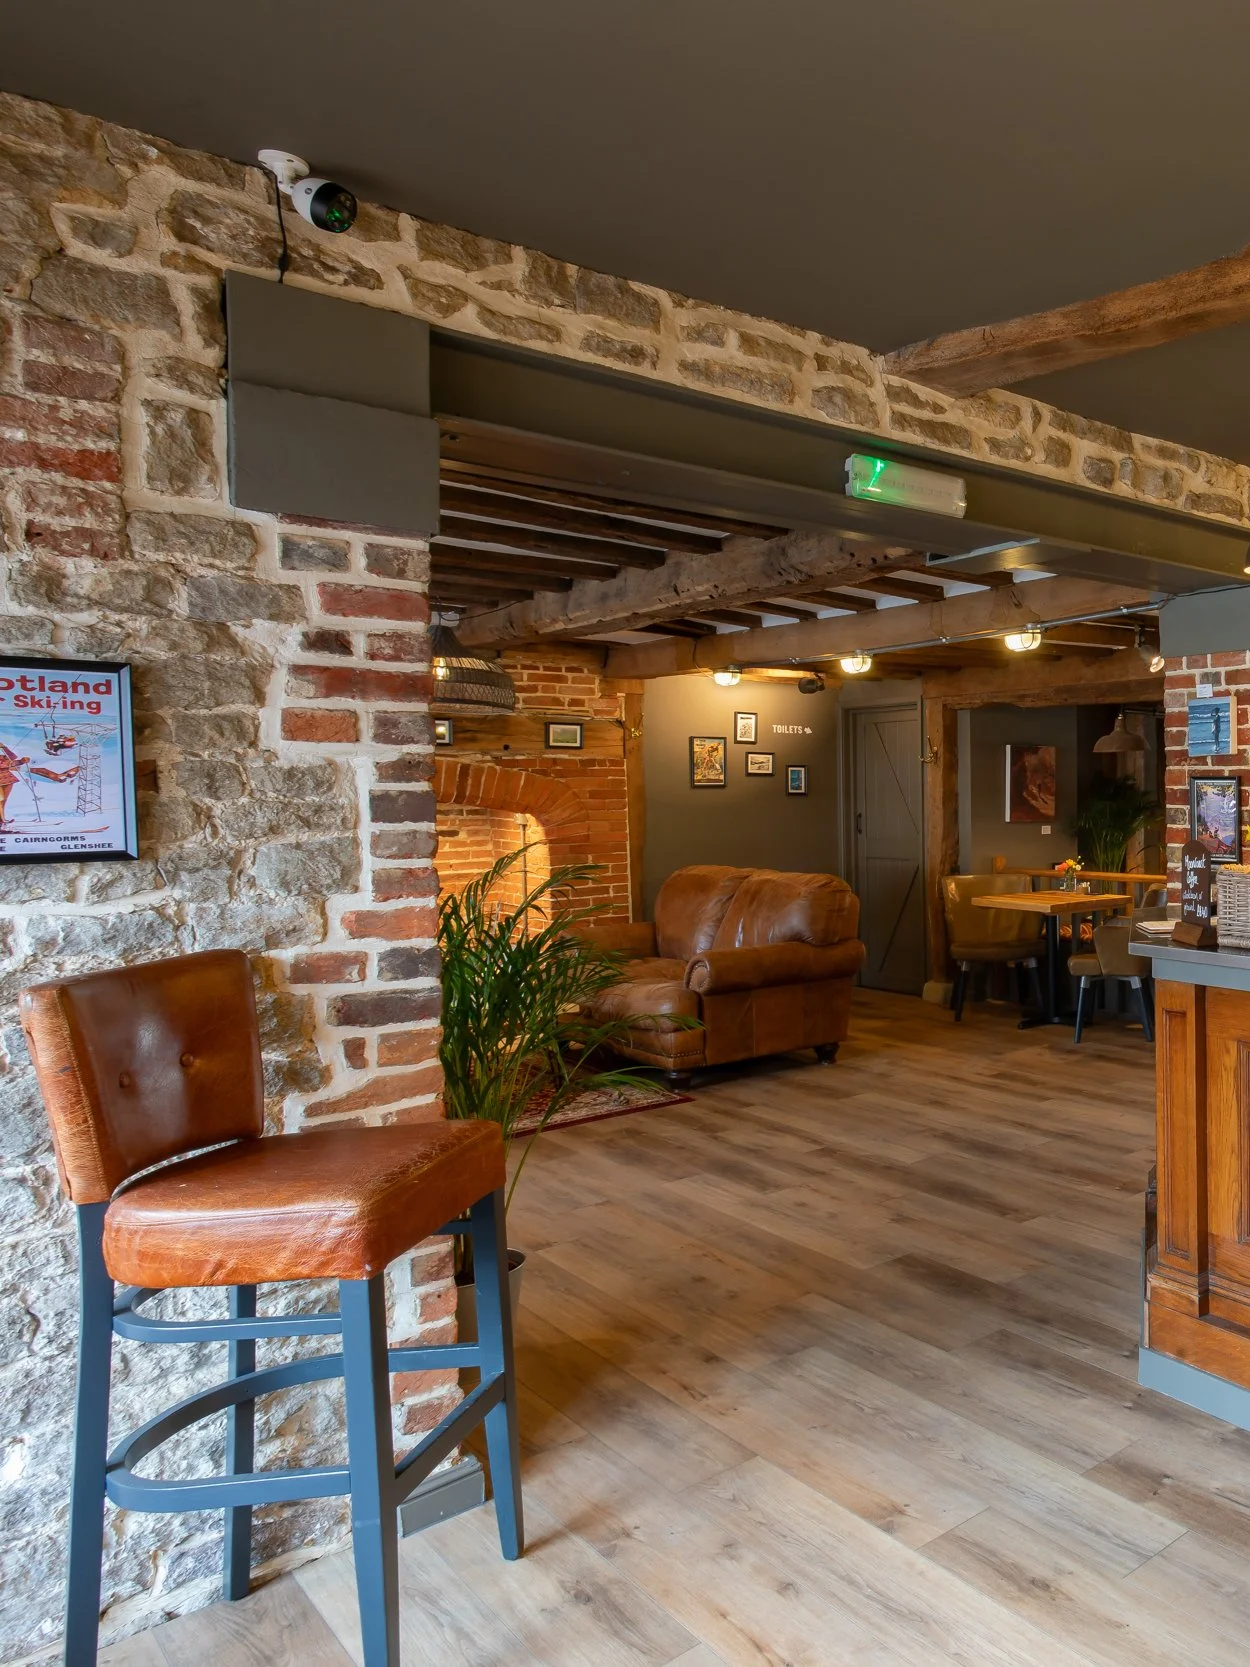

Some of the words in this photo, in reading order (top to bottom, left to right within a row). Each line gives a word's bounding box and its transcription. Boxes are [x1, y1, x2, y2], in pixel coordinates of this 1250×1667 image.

[14, 694, 102, 714] Ski-ing
[771, 724, 803, 734] TOILETS
[15, 835, 86, 844] CAIRNGORMS
